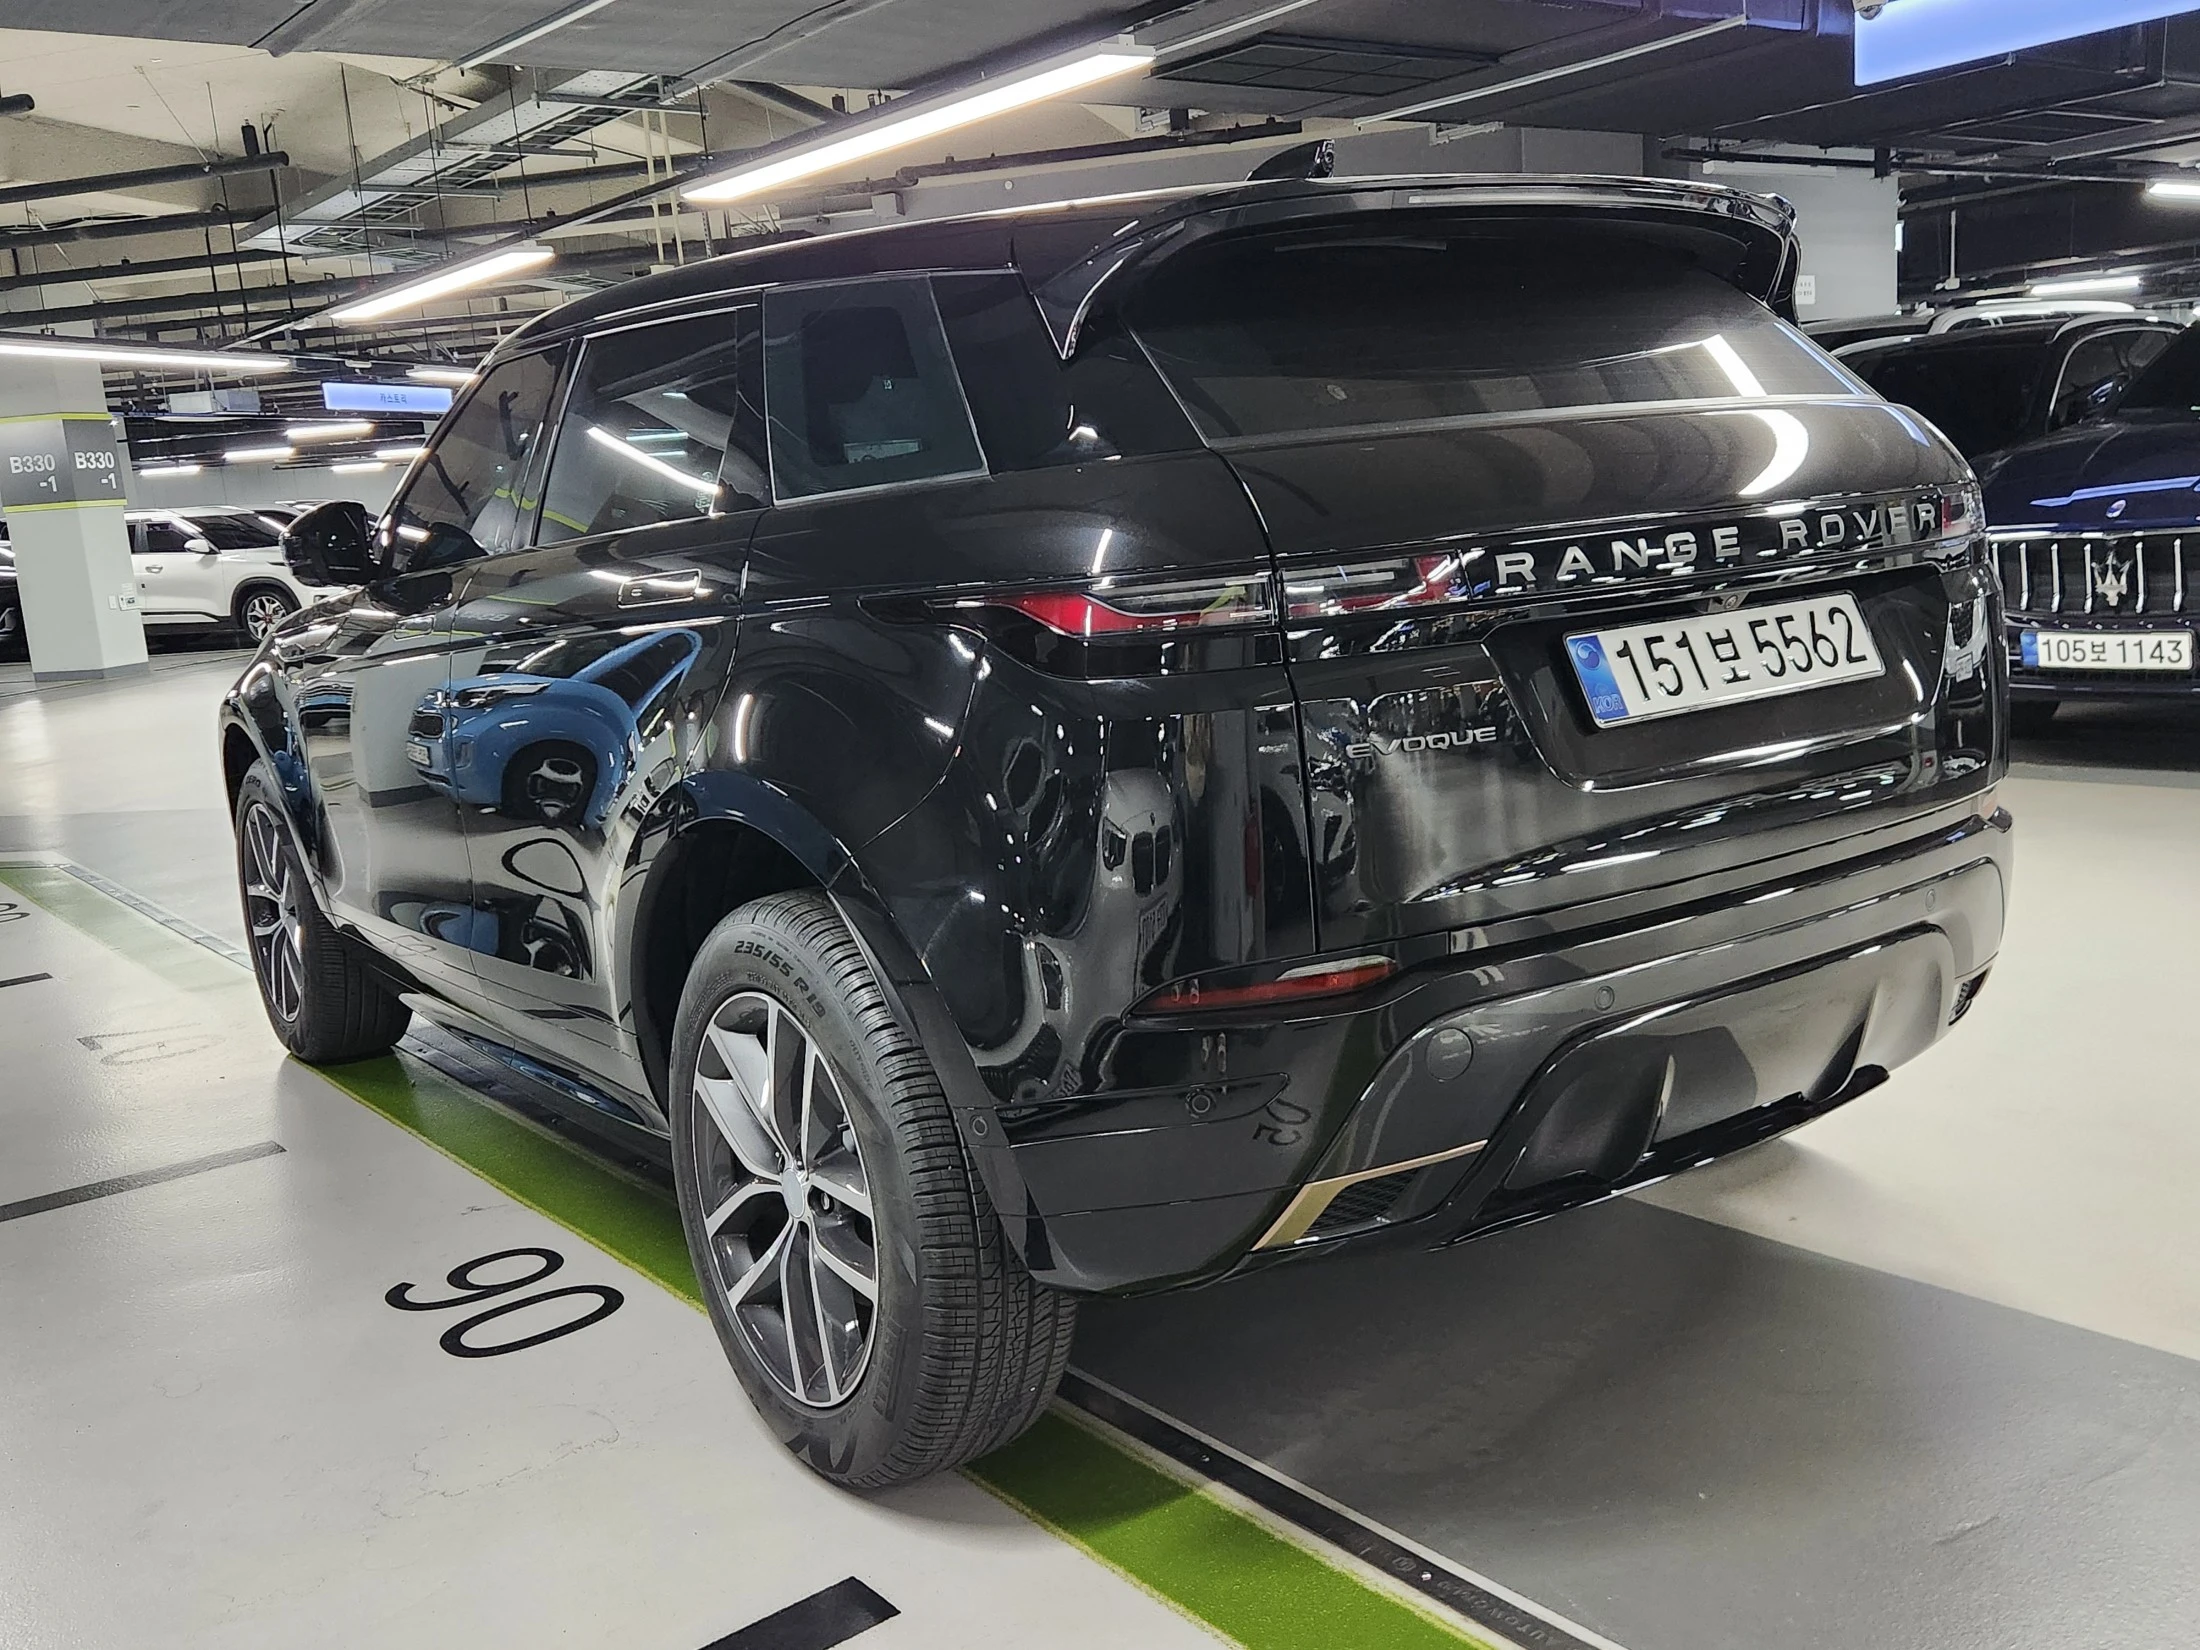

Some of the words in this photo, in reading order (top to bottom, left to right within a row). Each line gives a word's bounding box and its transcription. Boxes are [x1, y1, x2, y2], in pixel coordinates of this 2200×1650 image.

[10, 454, 55, 473] B330
[75, 452, 115, 469] B330
[40, 475, 57, 492] -1
[101, 473, 117, 489] -1
[1496, 525, 1741, 585] RANGE
[1779, 502, 1937, 550] ROVER
[1592, 692, 1625, 714] KOR
[1346, 726, 1497, 759] EVOQUE
[733, 940, 794, 978] 235/55
